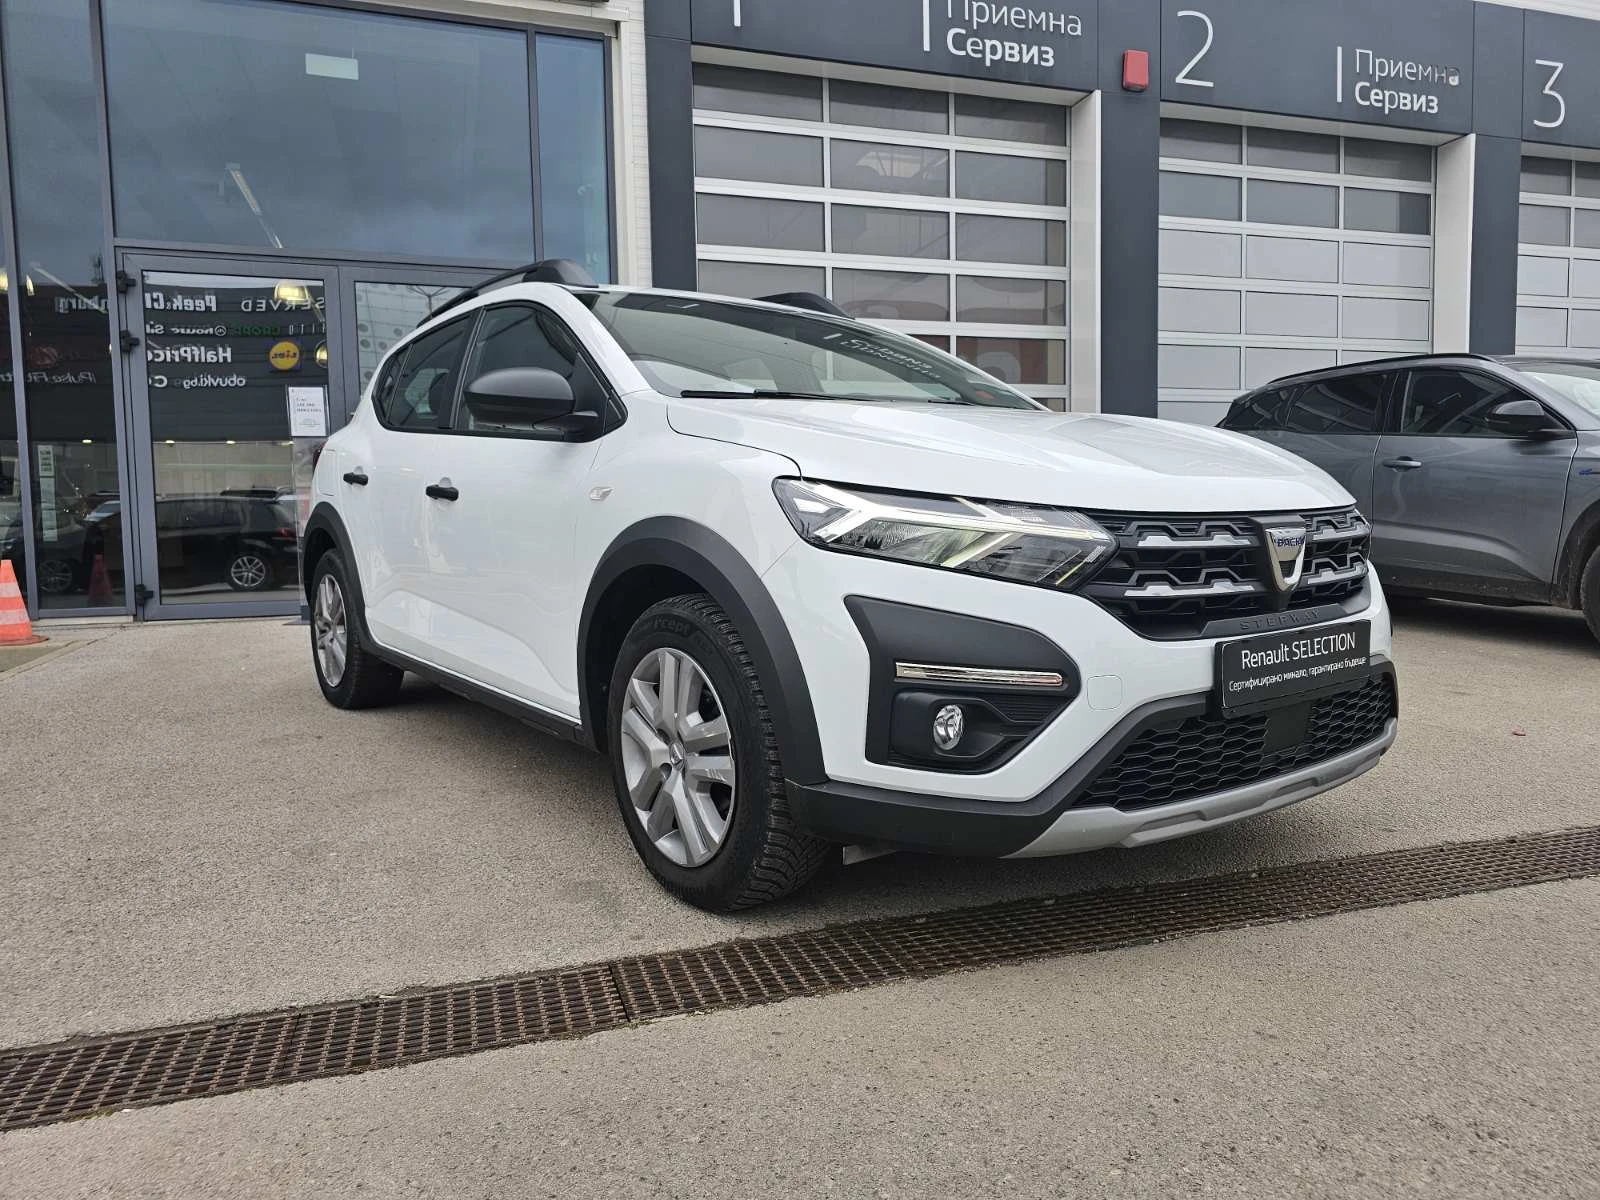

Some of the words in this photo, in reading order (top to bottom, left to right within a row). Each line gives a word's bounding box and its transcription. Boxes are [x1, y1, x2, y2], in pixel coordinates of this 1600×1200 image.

[946, 27, 1055, 67] Сервиз
[1175, 10, 1214, 88] 2
[1355, 48, 1460, 86] Приемна
[1355, 81, 1439, 115] Сервиз
[1533, 59, 1565, 128] 3
[1240, 609, 1321, 631] STEPWAY
[1241, 643, 1289, 669] Renault
[1292, 631, 1356, 660] SELECTION
[1229, 673, 1283, 692] Сертифицирано
[1308, 661, 1344, 677] гарантирано
